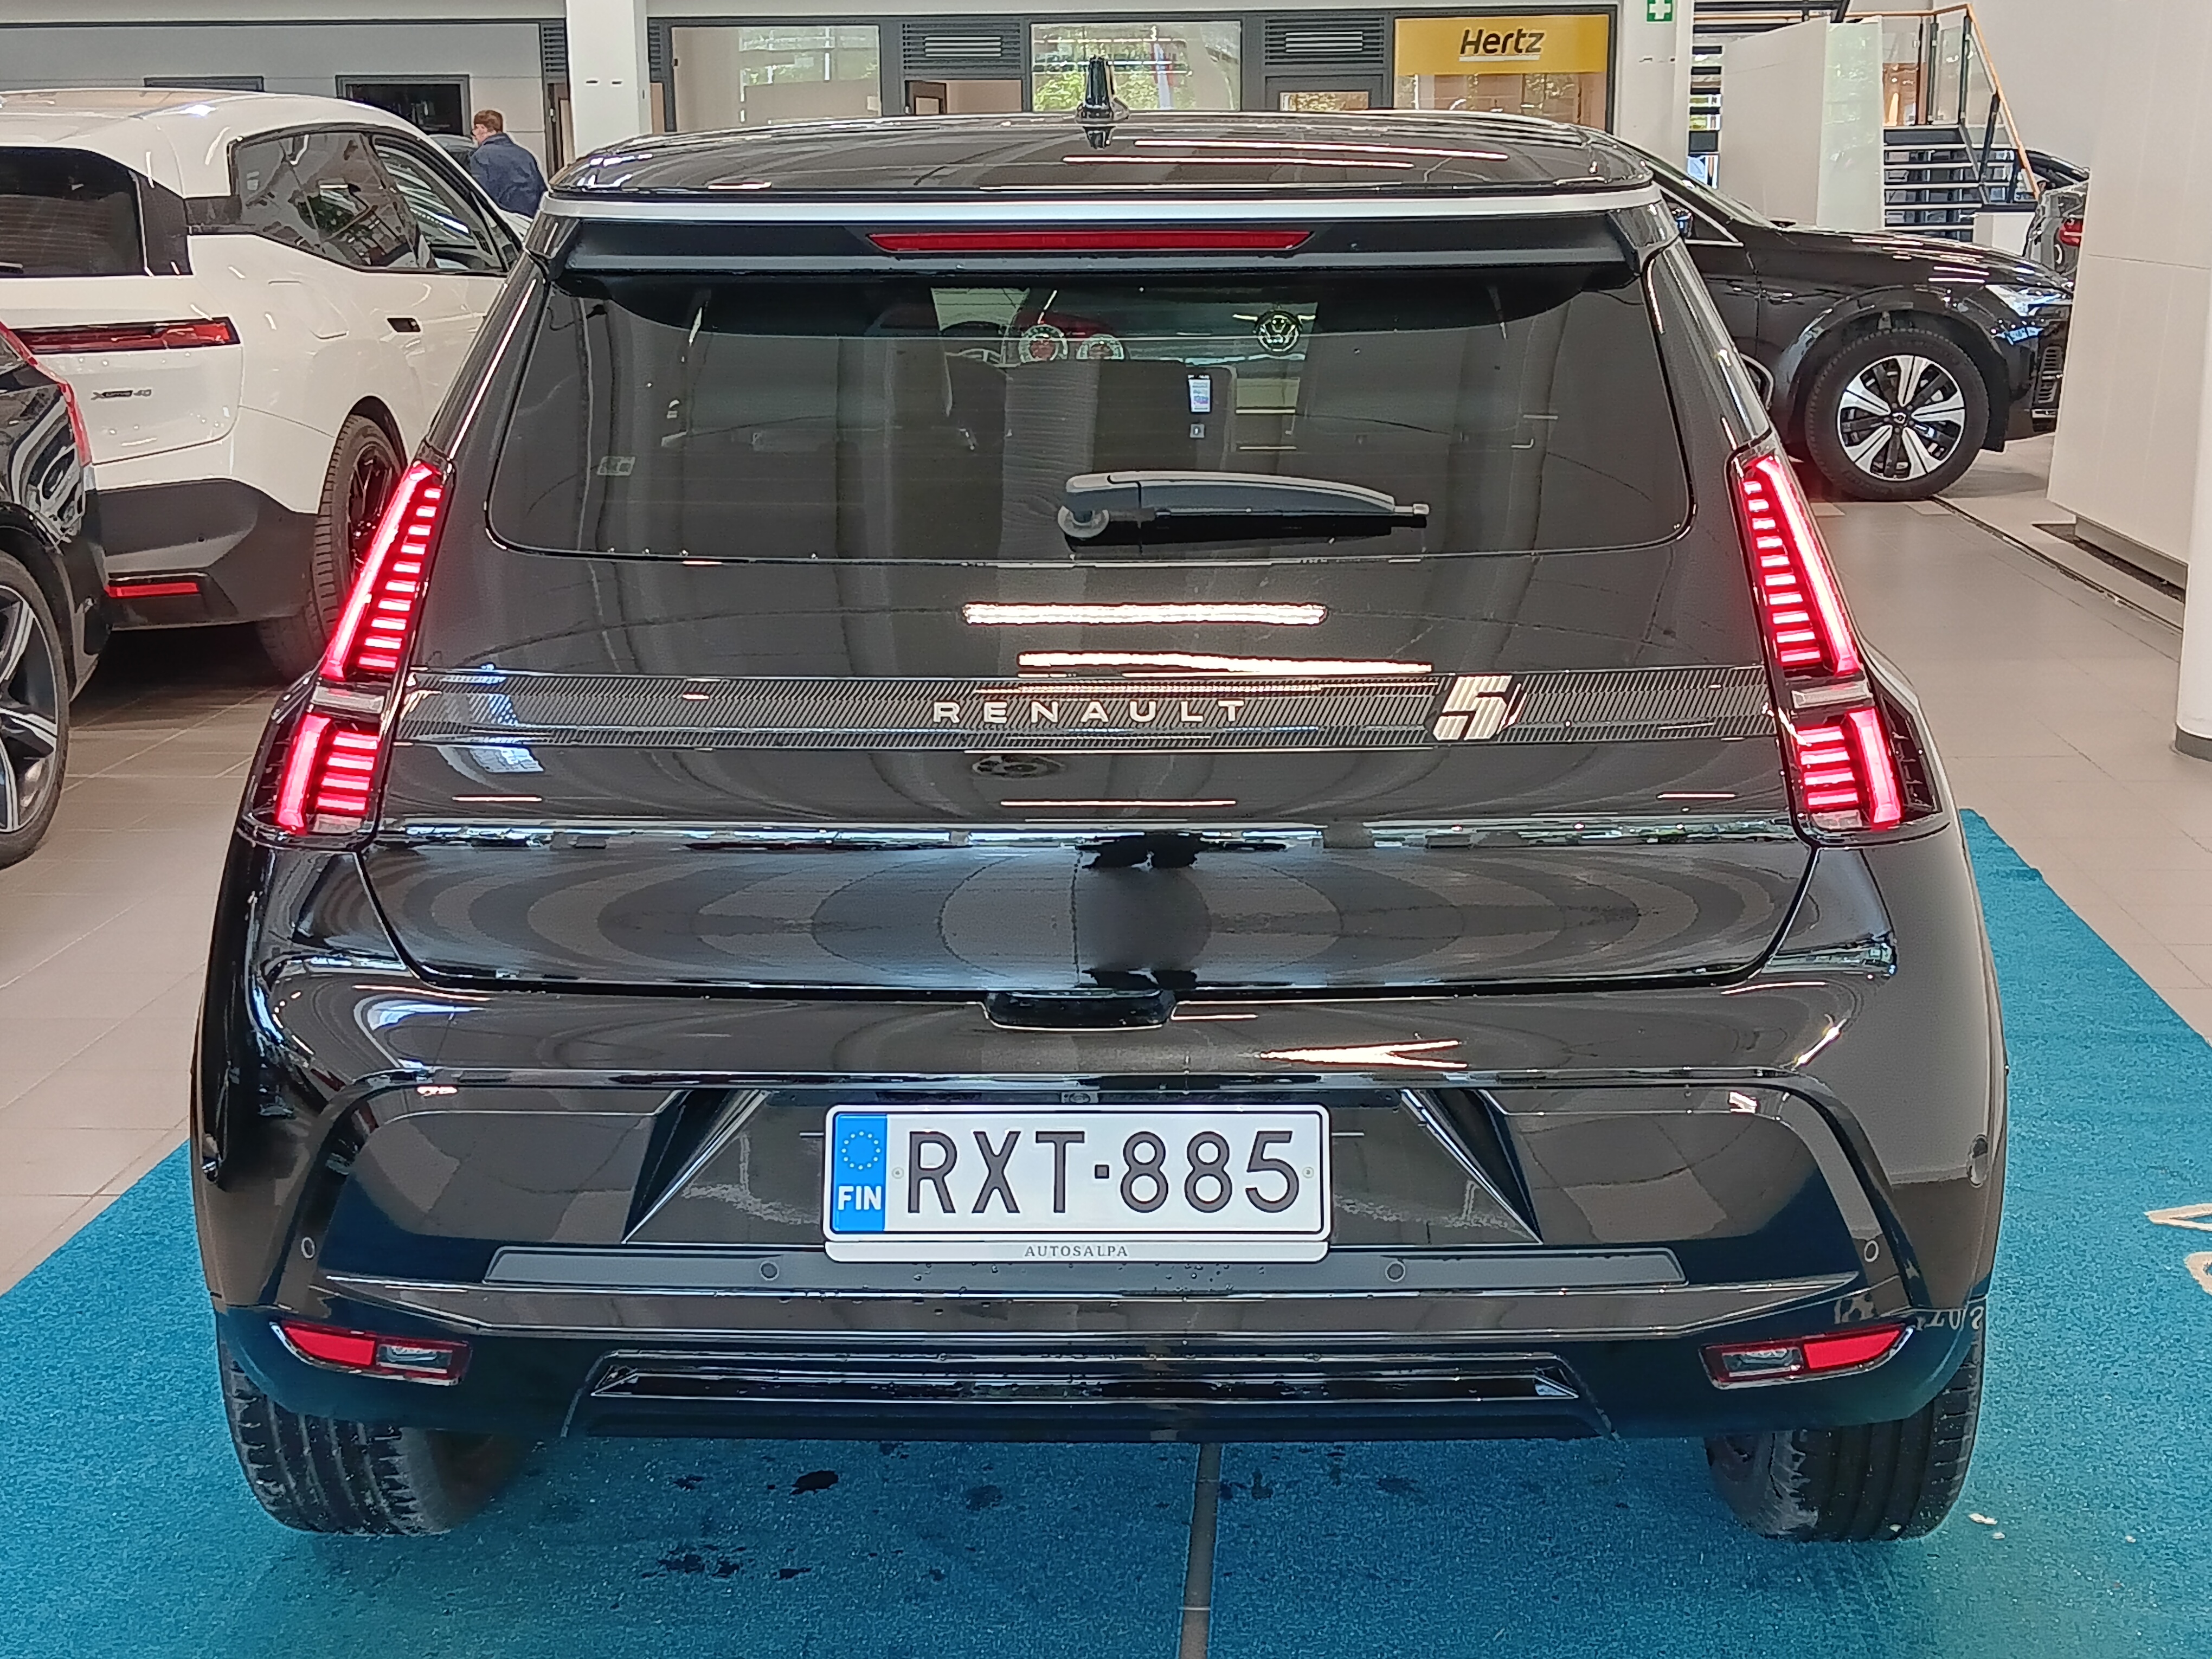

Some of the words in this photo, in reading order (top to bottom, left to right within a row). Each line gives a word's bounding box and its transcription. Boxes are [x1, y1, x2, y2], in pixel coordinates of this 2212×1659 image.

[1459, 28, 1545, 55] Hertz
[933, 700, 1245, 723] RENAULT
[1432, 676, 1513, 741] 5
[837, 1186, 882, 1211] FIN
[1024, 1245, 1129, 1257] AUTOSALPA
